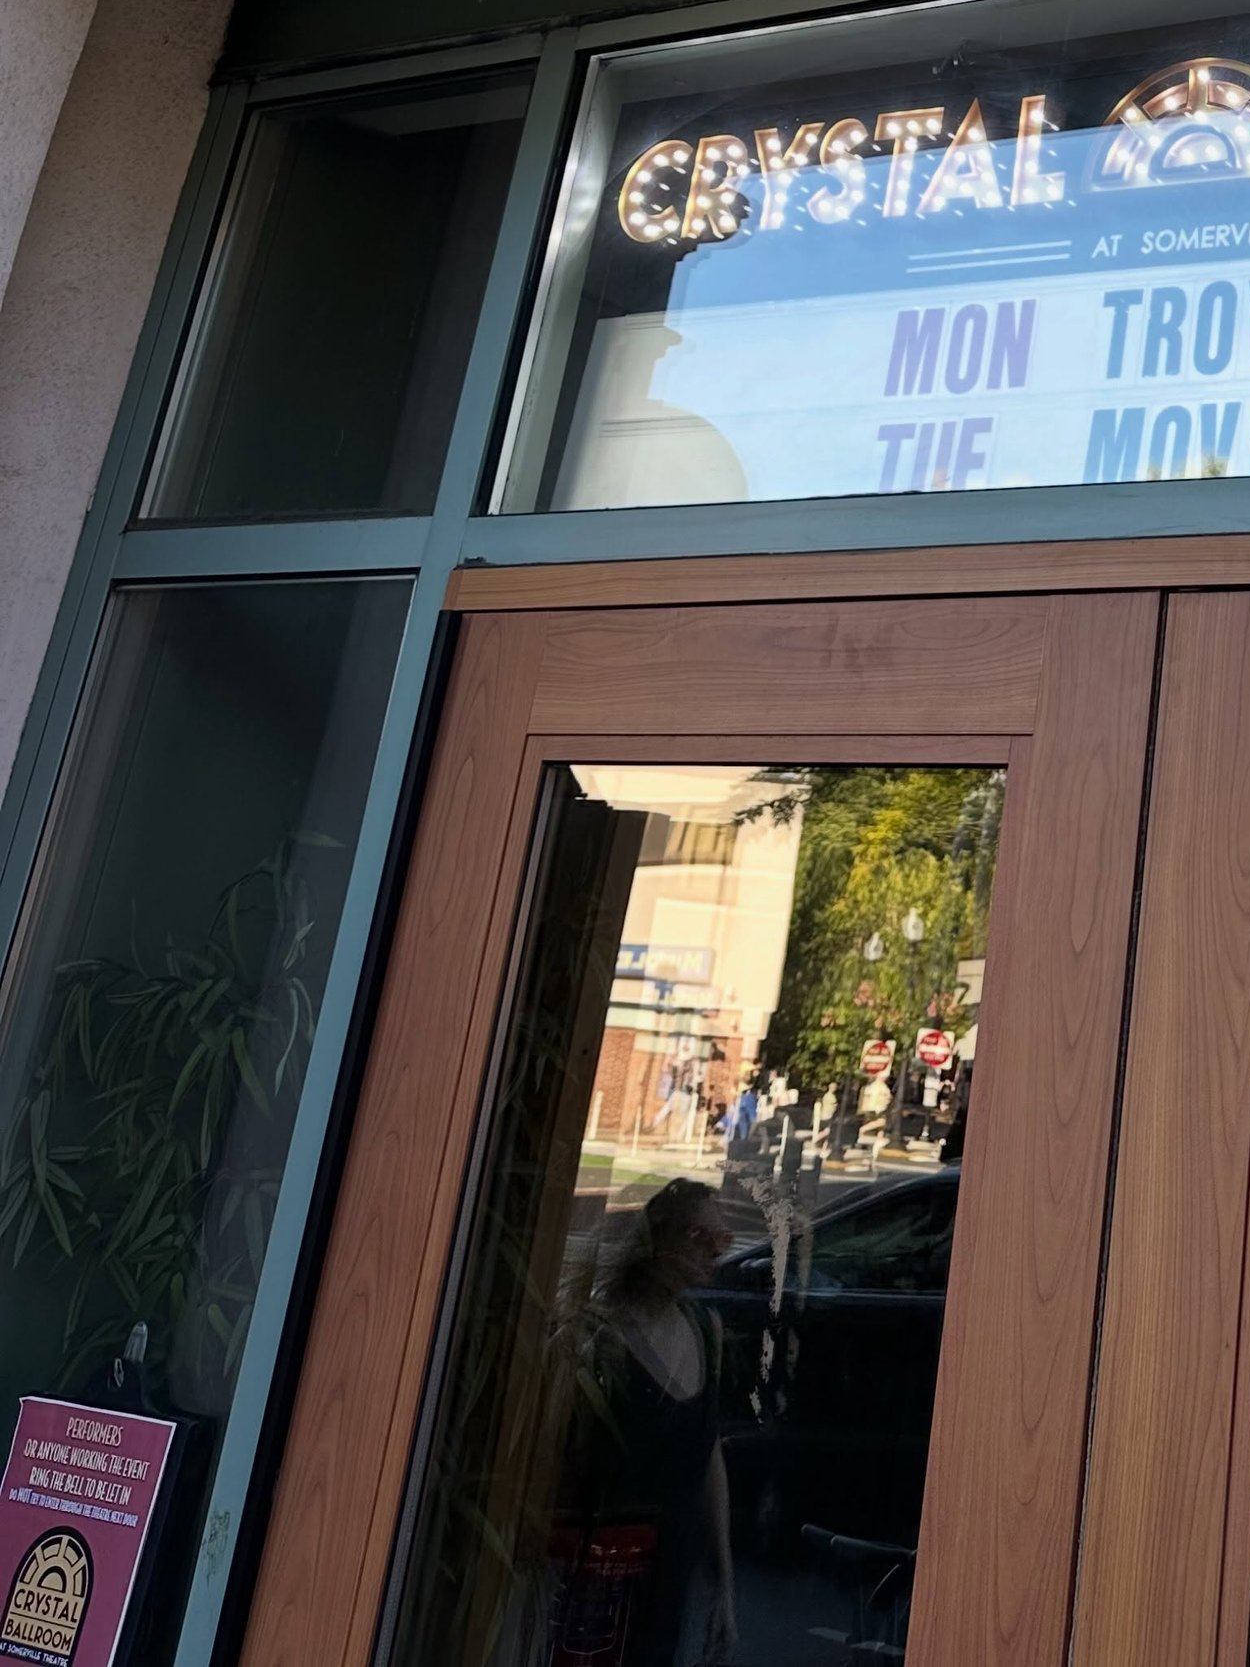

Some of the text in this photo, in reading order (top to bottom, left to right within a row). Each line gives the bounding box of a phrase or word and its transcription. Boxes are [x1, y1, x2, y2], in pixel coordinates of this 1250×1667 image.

[618, 94, 1066, 243] CRYSTAL
[1092, 235, 1123, 259] AT
[884, 298, 1038, 397] MON
[66, 1418, 124, 1446] PERFORMERS
[24, 1439, 150, 1479] OR ANYONE WORKING THE EVENT
[17, 1488, 32, 1503] NOT
[29, 1467, 132, 1504] RING THE BELL TO BE LET IN
[14, 1588, 78, 1623] CRYSTAL
[5, 1619, 72, 1650] BALLROOM
[7, 1644, 42, 1660] SOMERVILLE
[42, 1652, 69, 1667] THEATRE
